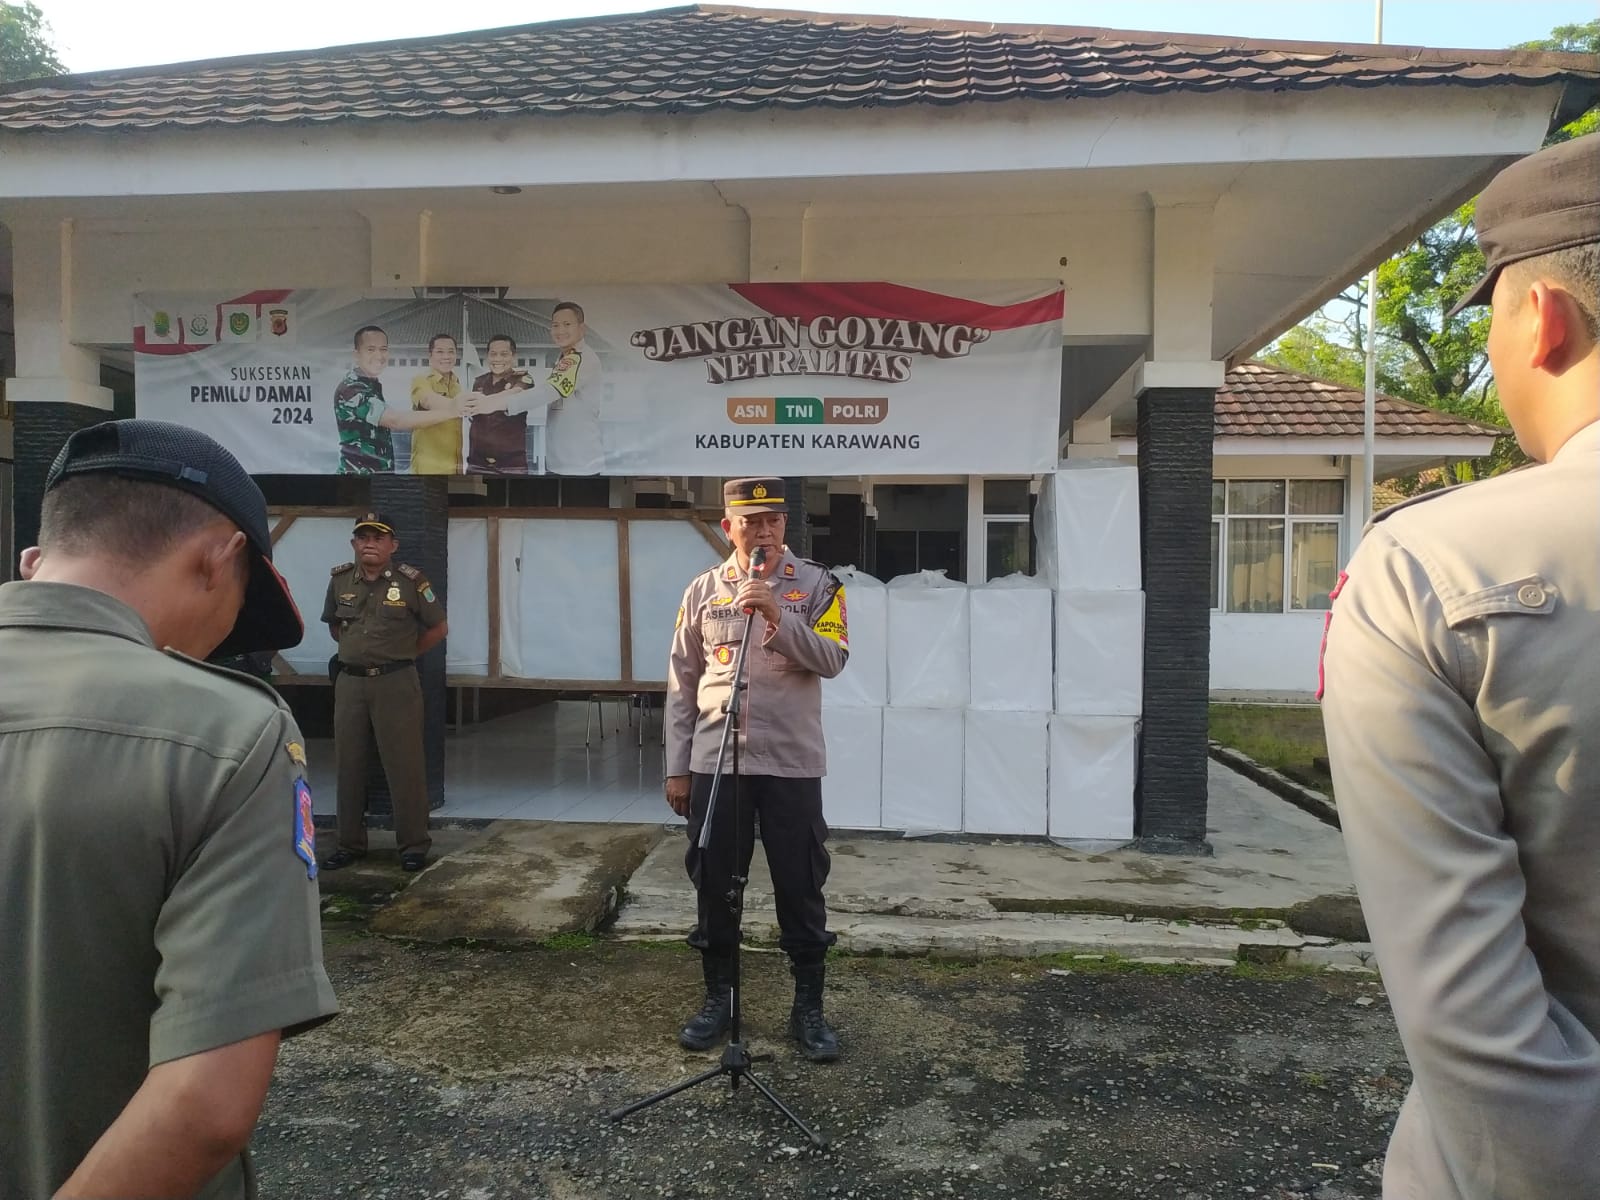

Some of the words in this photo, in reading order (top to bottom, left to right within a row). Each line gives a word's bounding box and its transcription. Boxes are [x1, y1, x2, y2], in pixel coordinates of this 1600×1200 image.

[231, 366, 311, 381] SUKSESKAN
[704, 349, 913, 384] NETRALITAS
[190, 386, 250, 403] PEMILU
[255, 385, 312, 403] DAMAI
[271, 407, 313, 425] 2024
[734, 404, 768, 418] ASN
[785, 404, 813, 418] TNI
[832, 404, 880, 418] POLRI
[695, 434, 805, 449] KABUPATEN
[812, 434, 920, 449] KARAWANG
